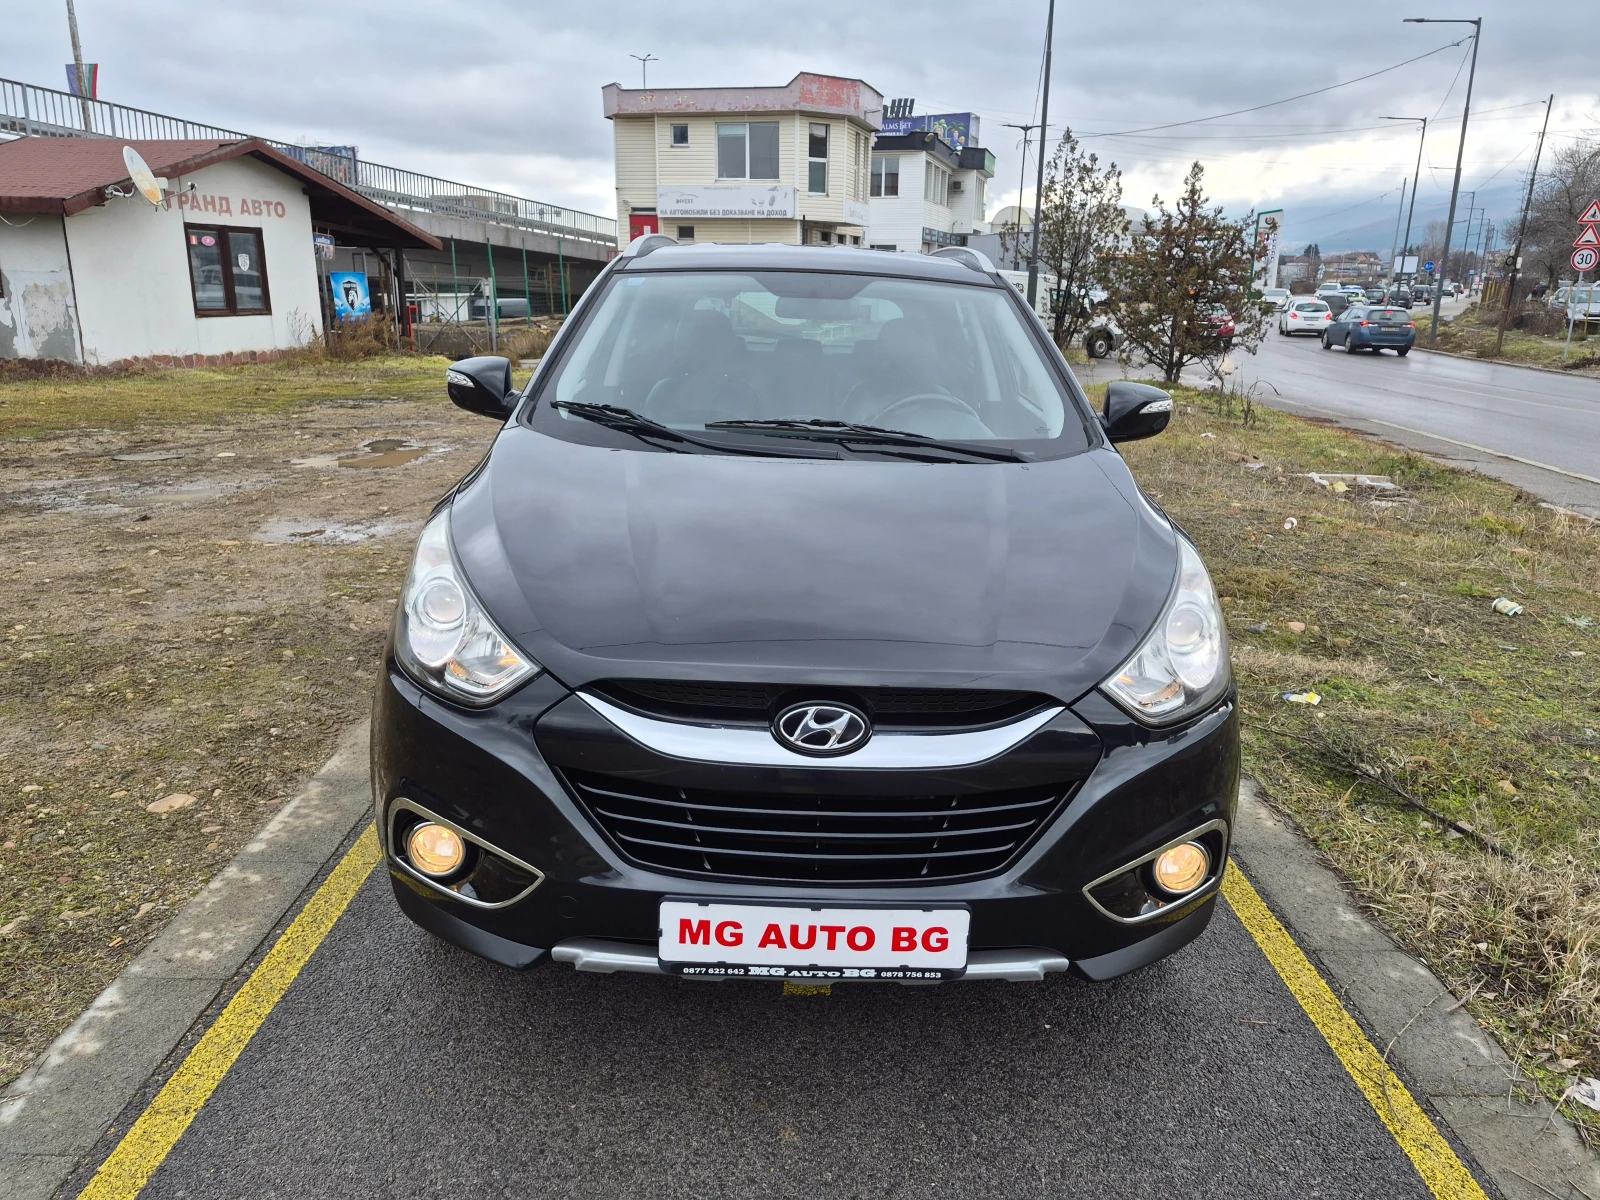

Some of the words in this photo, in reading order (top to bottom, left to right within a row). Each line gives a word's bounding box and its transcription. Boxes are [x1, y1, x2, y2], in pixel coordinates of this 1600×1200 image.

[881, 122, 899, 130] ALMS
[165, 190, 233, 217] ГРАНД
[240, 198, 286, 219] АВТО
[721, 209, 756, 217] ДОКАЗВАНЕ
[757, 209, 765, 217] НА
[766, 209, 787, 217] ДОХОД
[1577, 253, 1592, 264] 30
[679, 918, 744, 947] MG
[757, 923, 876, 952] AUTO
[891, 926, 949, 953] BG
[708, 967, 726, 975] 622
[748, 966, 787, 976] MG
[842, 968, 877, 978] BG
